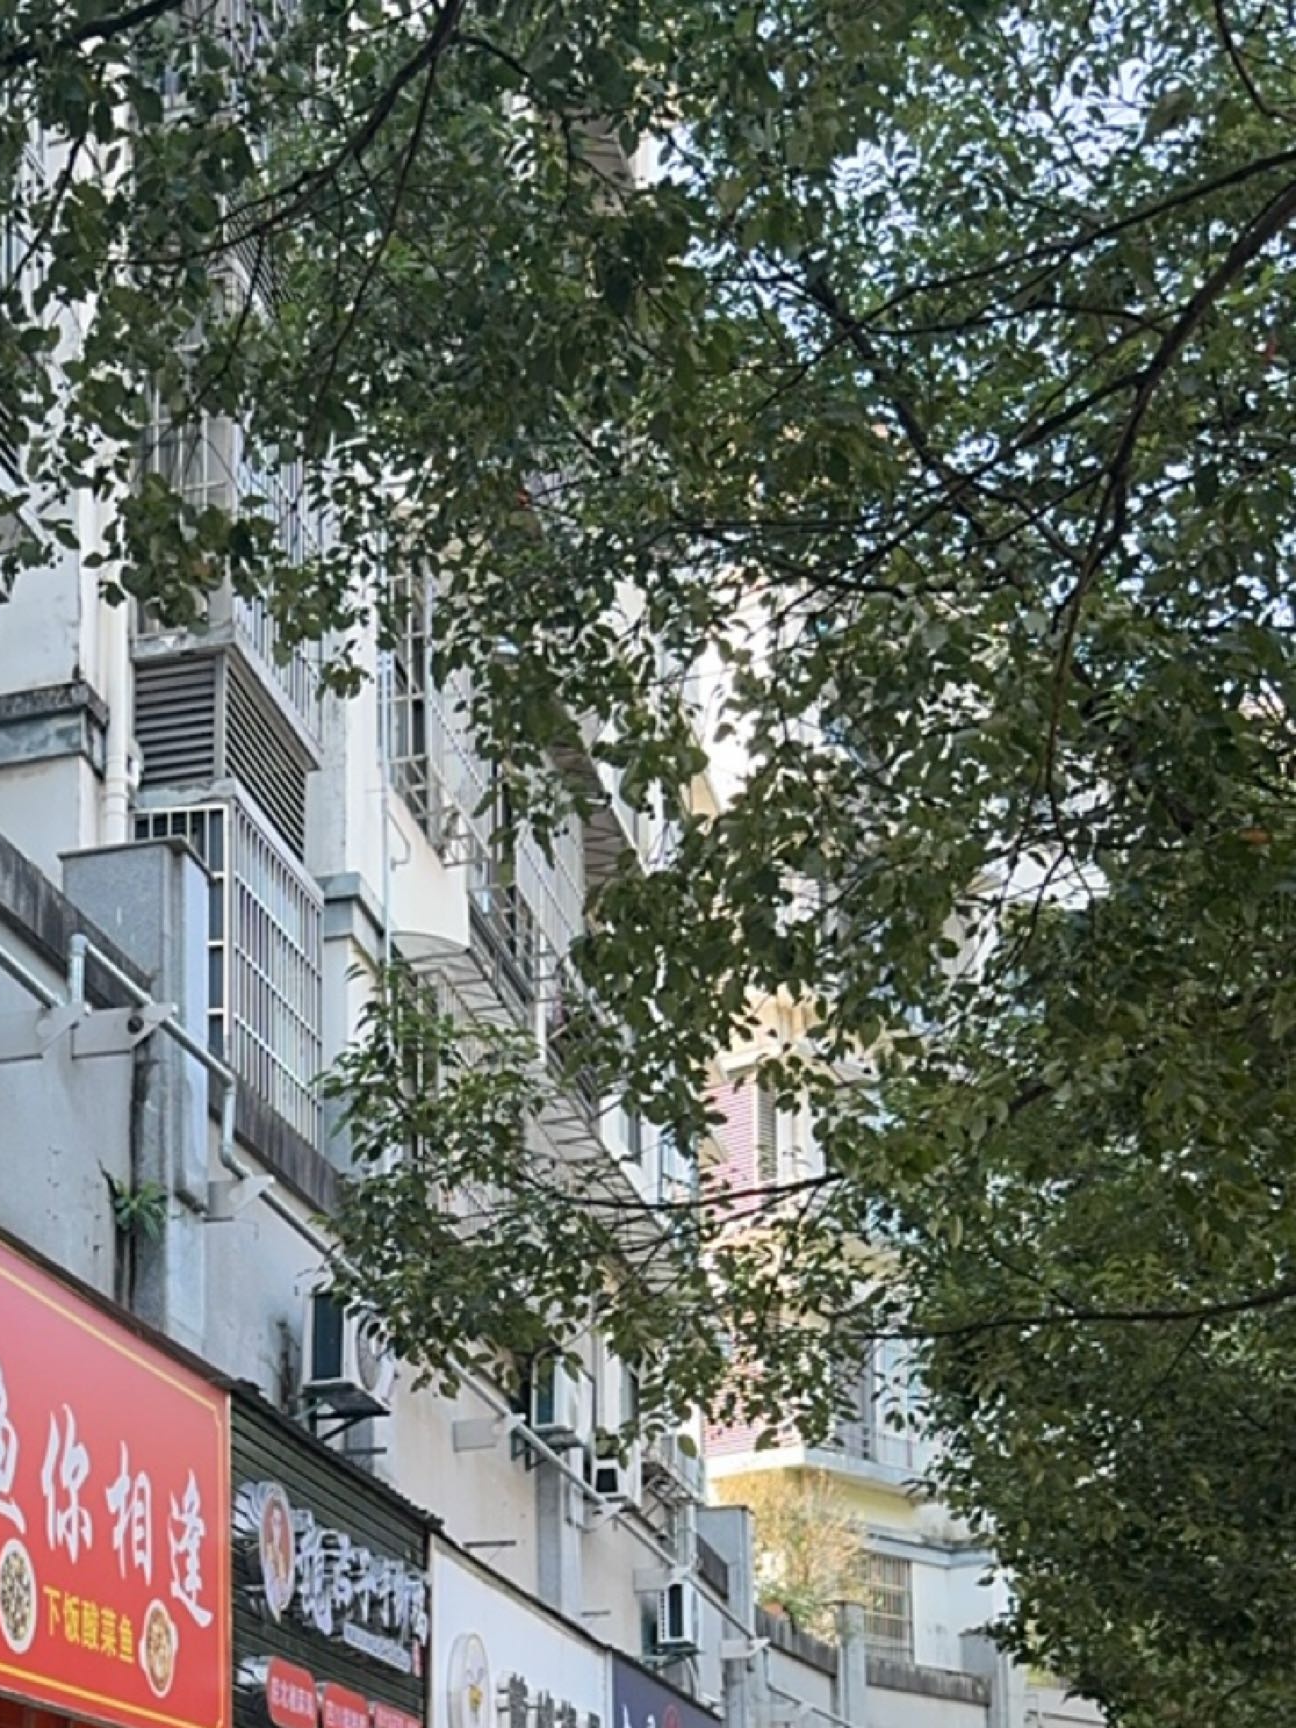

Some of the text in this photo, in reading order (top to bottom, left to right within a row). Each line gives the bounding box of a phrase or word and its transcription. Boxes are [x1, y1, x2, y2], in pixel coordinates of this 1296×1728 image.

[42, 1583, 136, 1666] 下饭酸菜鱼
